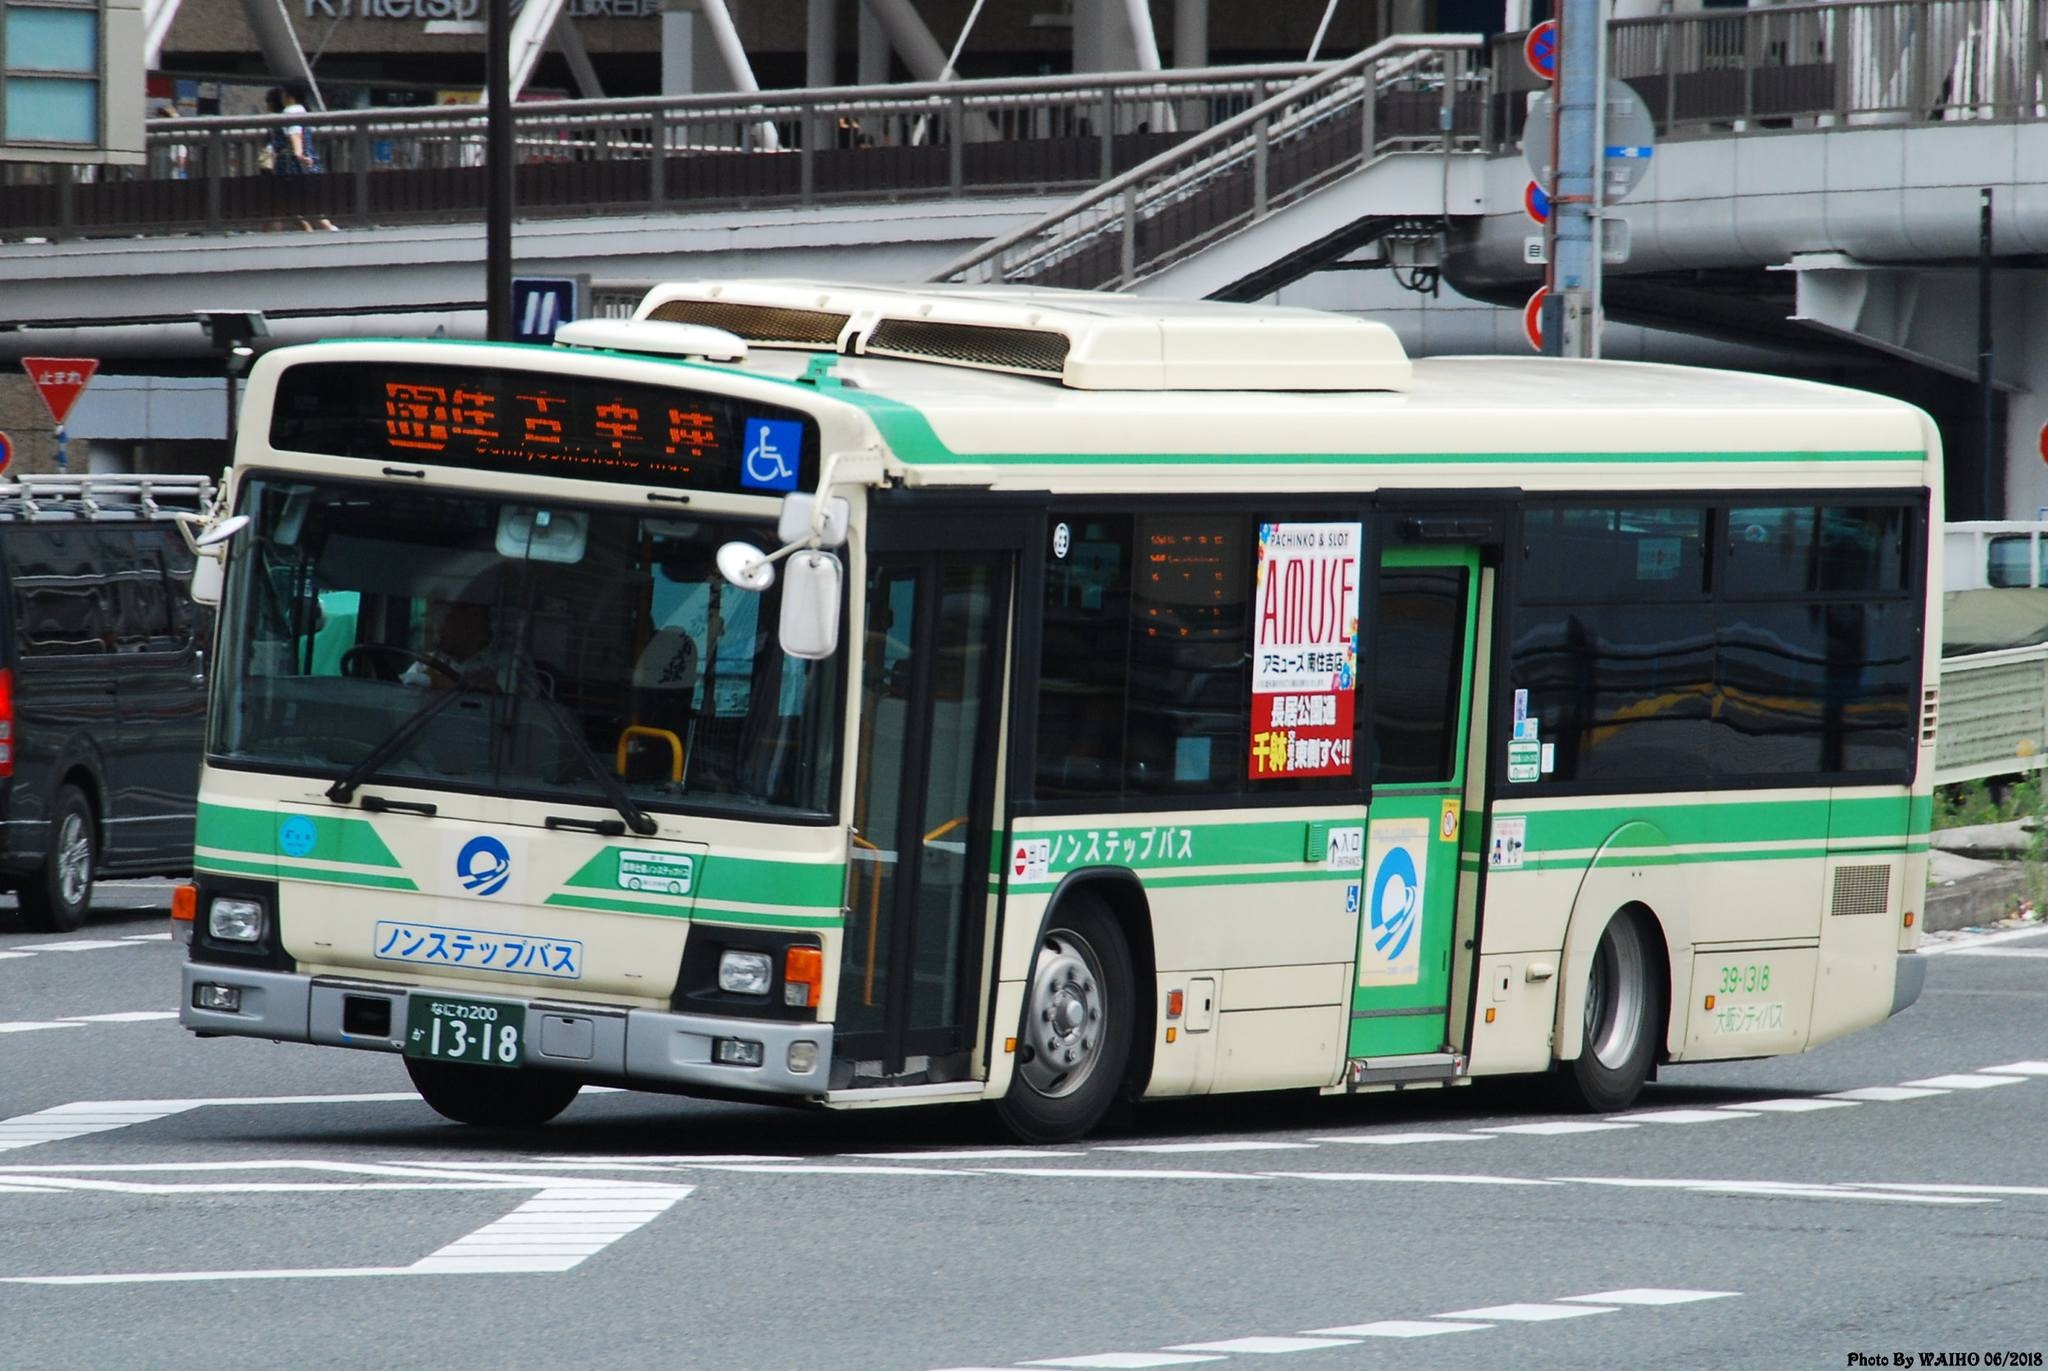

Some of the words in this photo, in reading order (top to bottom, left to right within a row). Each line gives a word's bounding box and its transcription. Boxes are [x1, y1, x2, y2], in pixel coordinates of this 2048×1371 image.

[39, 370, 83, 385] 止まれ
[1271, 533, 1315, 547] PACHINKO
[1318, 533, 1325, 546] &
[1328, 533, 1349, 546] SLOT
[1261, 558, 1354, 645] AMUSE
[1263, 652, 1305, 673] アミューズ
[1049, 827, 1193, 865] ノンステップバス
[1340, 832, 1360, 852] 入口
[380, 928, 575, 972] ノンステップバス
[1713, 1004, 1782, 1034] 大阪シティバス
[431, 1017, 518, 1063] 13-18
